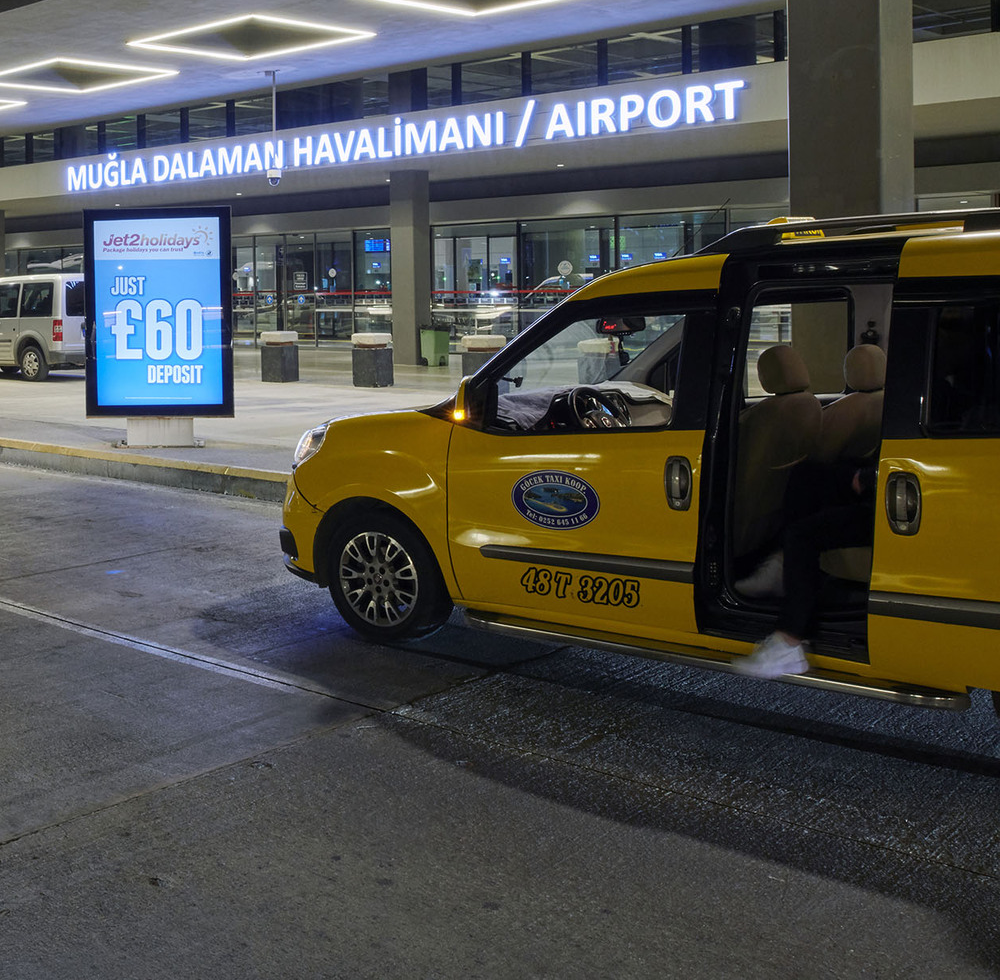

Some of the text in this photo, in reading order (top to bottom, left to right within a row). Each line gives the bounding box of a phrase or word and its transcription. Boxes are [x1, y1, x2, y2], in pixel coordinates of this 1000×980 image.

[67, 152, 147, 191] MUĞLA
[153, 140, 284, 182] DALAMAN
[293, 111, 504, 167] HAVALİMANI
[545, 79, 745, 140] AIRPORT
[103, 233, 200, 249] Jet2holidays
[110, 276, 146, 296] JUST
[111, 298, 203, 361] £60
[147, 364, 204, 384] DEPOSIT
[545, 475, 563, 483] TAXI
[521, 567, 640, 608] 48 T 3205
